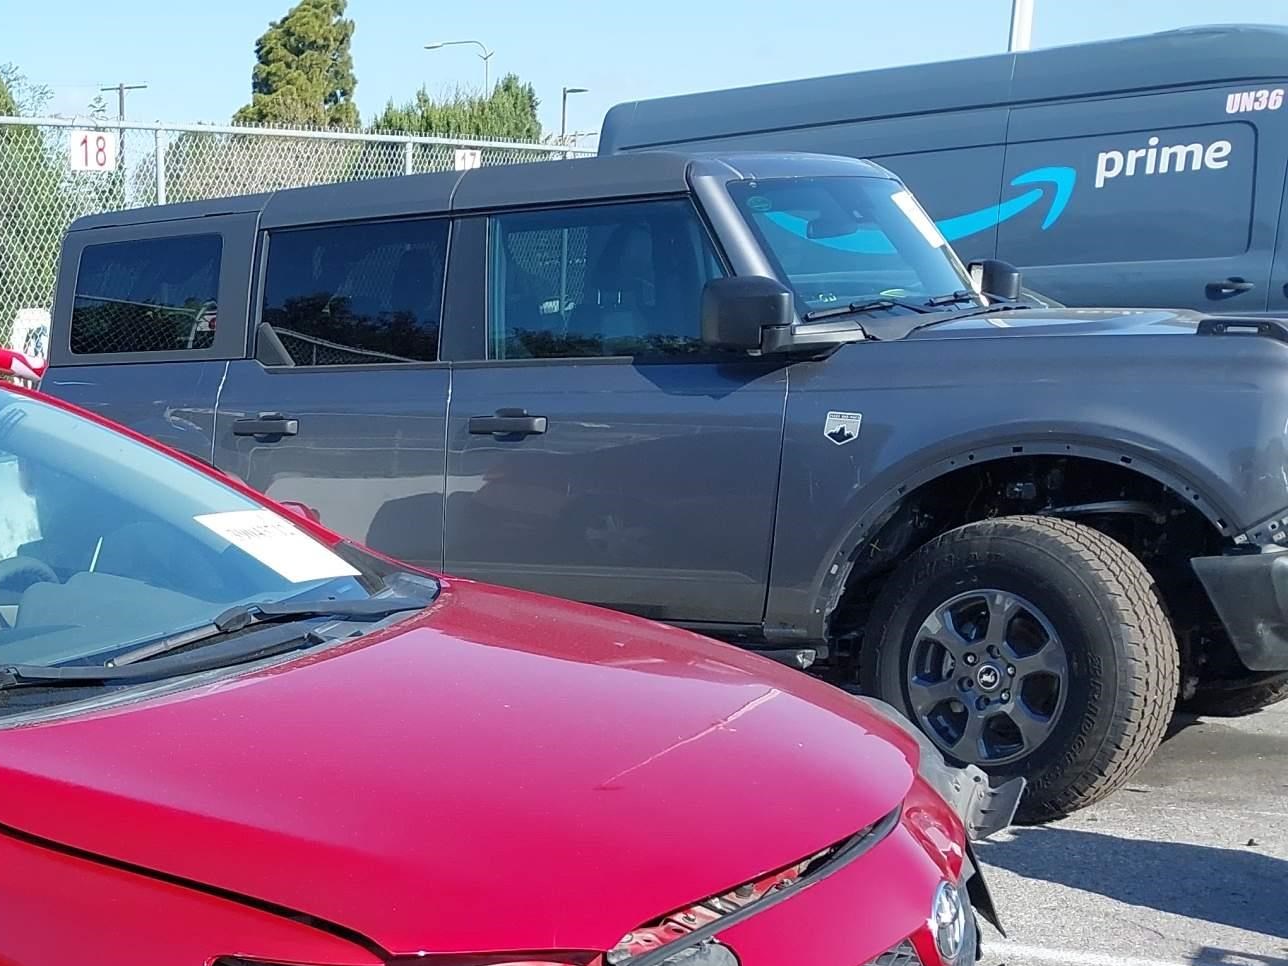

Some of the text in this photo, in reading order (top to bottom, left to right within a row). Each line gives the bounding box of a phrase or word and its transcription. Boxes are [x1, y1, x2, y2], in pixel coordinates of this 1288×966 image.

[1225, 89, 1285, 114] UN36
[80, 135, 107, 167] 18
[461, 152, 477, 169] 17
[1095, 136, 1232, 189] prime
